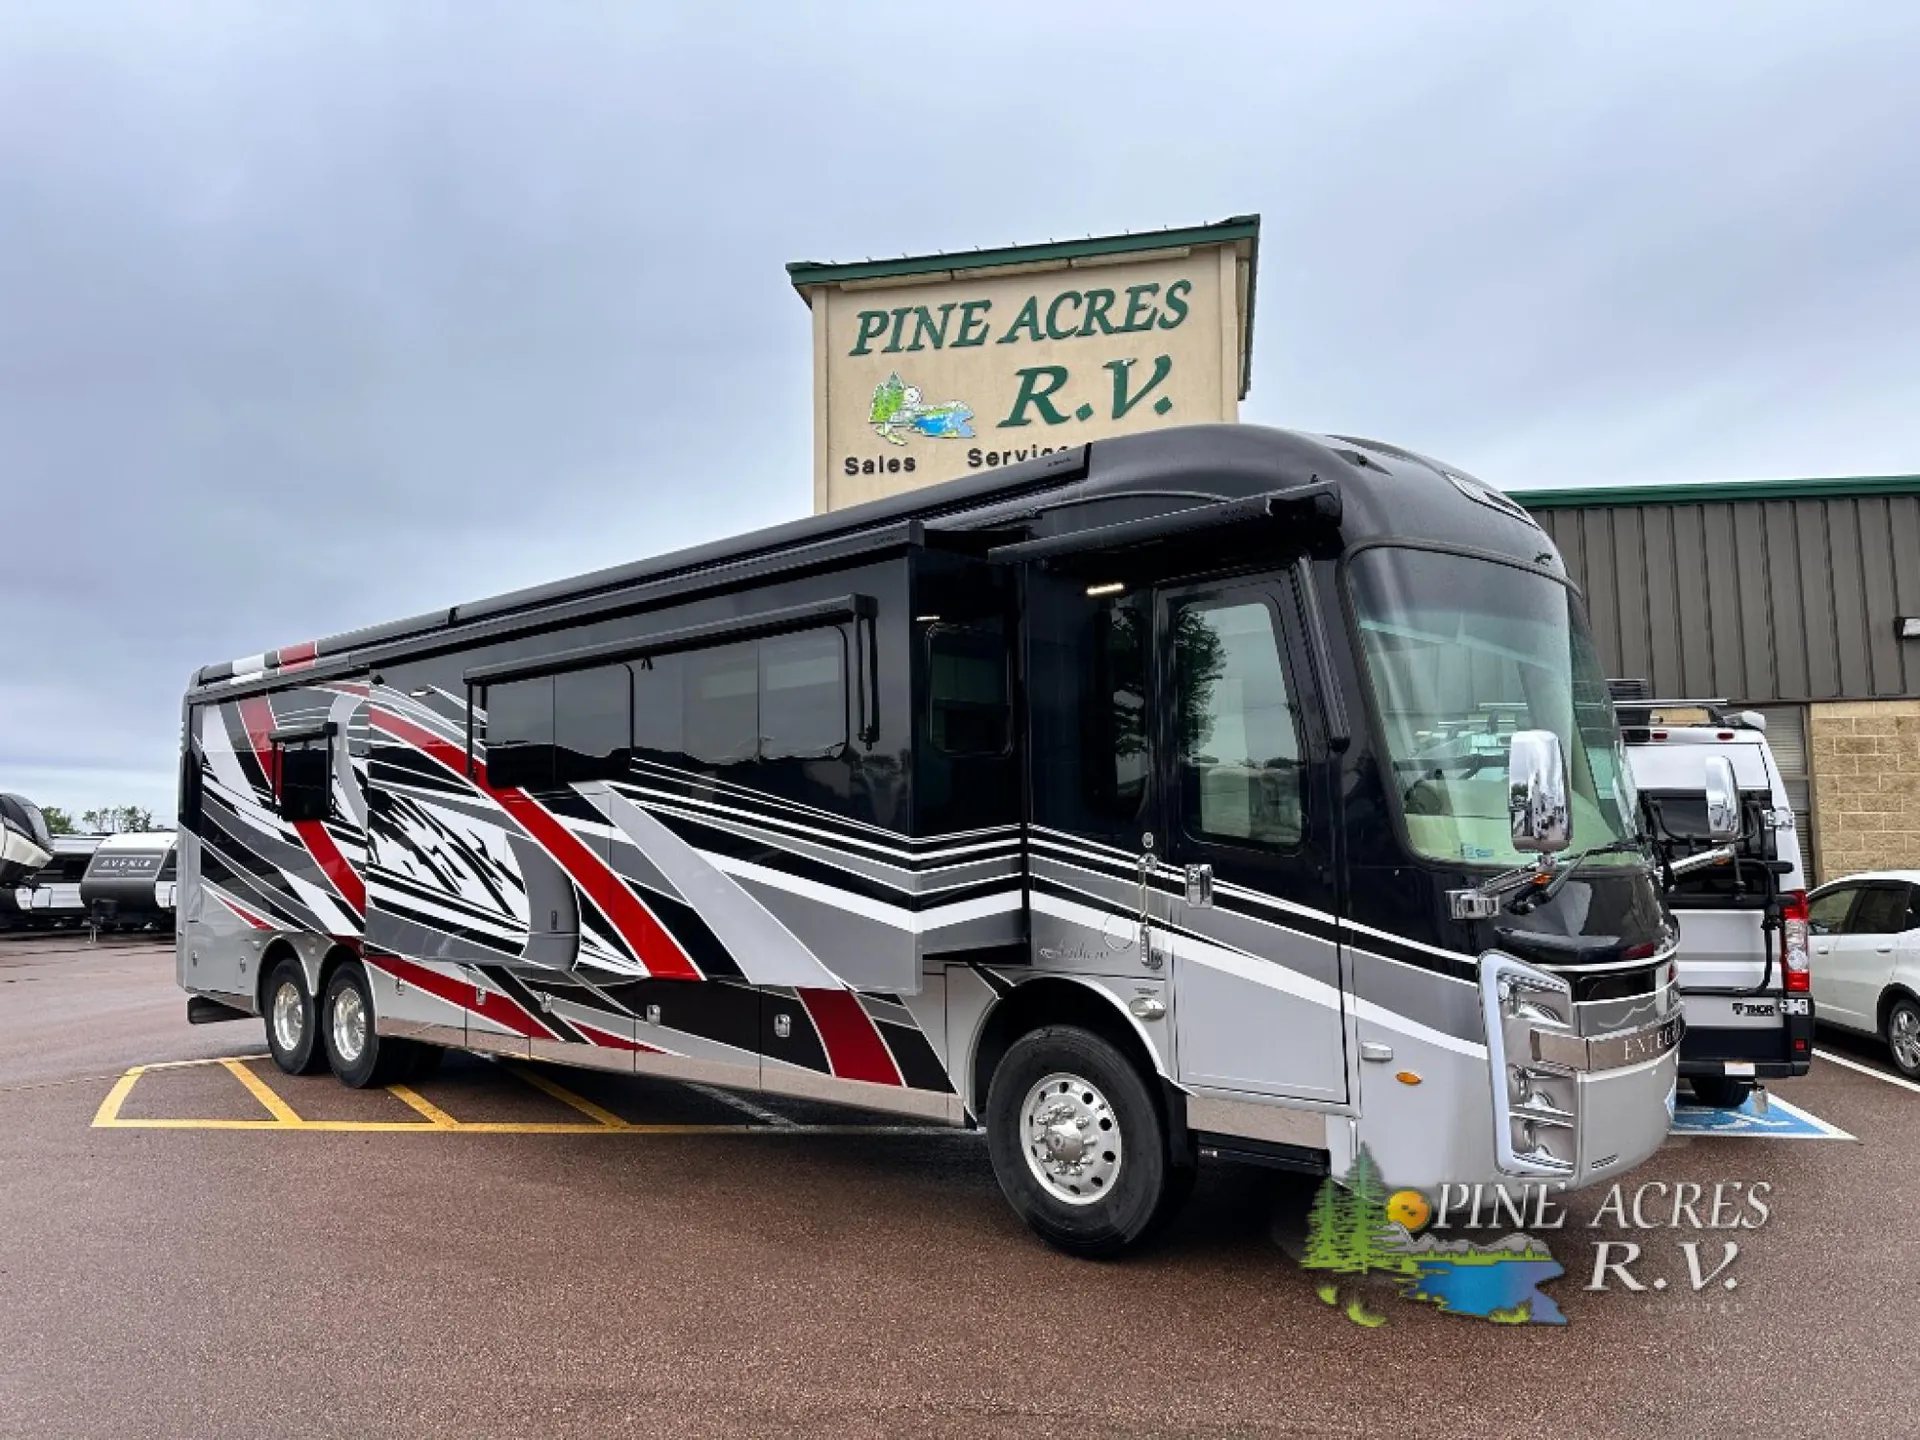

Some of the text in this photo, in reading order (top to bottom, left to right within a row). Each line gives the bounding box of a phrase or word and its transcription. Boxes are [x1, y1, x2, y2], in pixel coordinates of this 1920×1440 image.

[848, 279, 1192, 356] PINE ACRES
[996, 354, 1173, 428] R.V.
[844, 455, 917, 476] Sales
[1743, 1004, 1774, 1014] THOR
